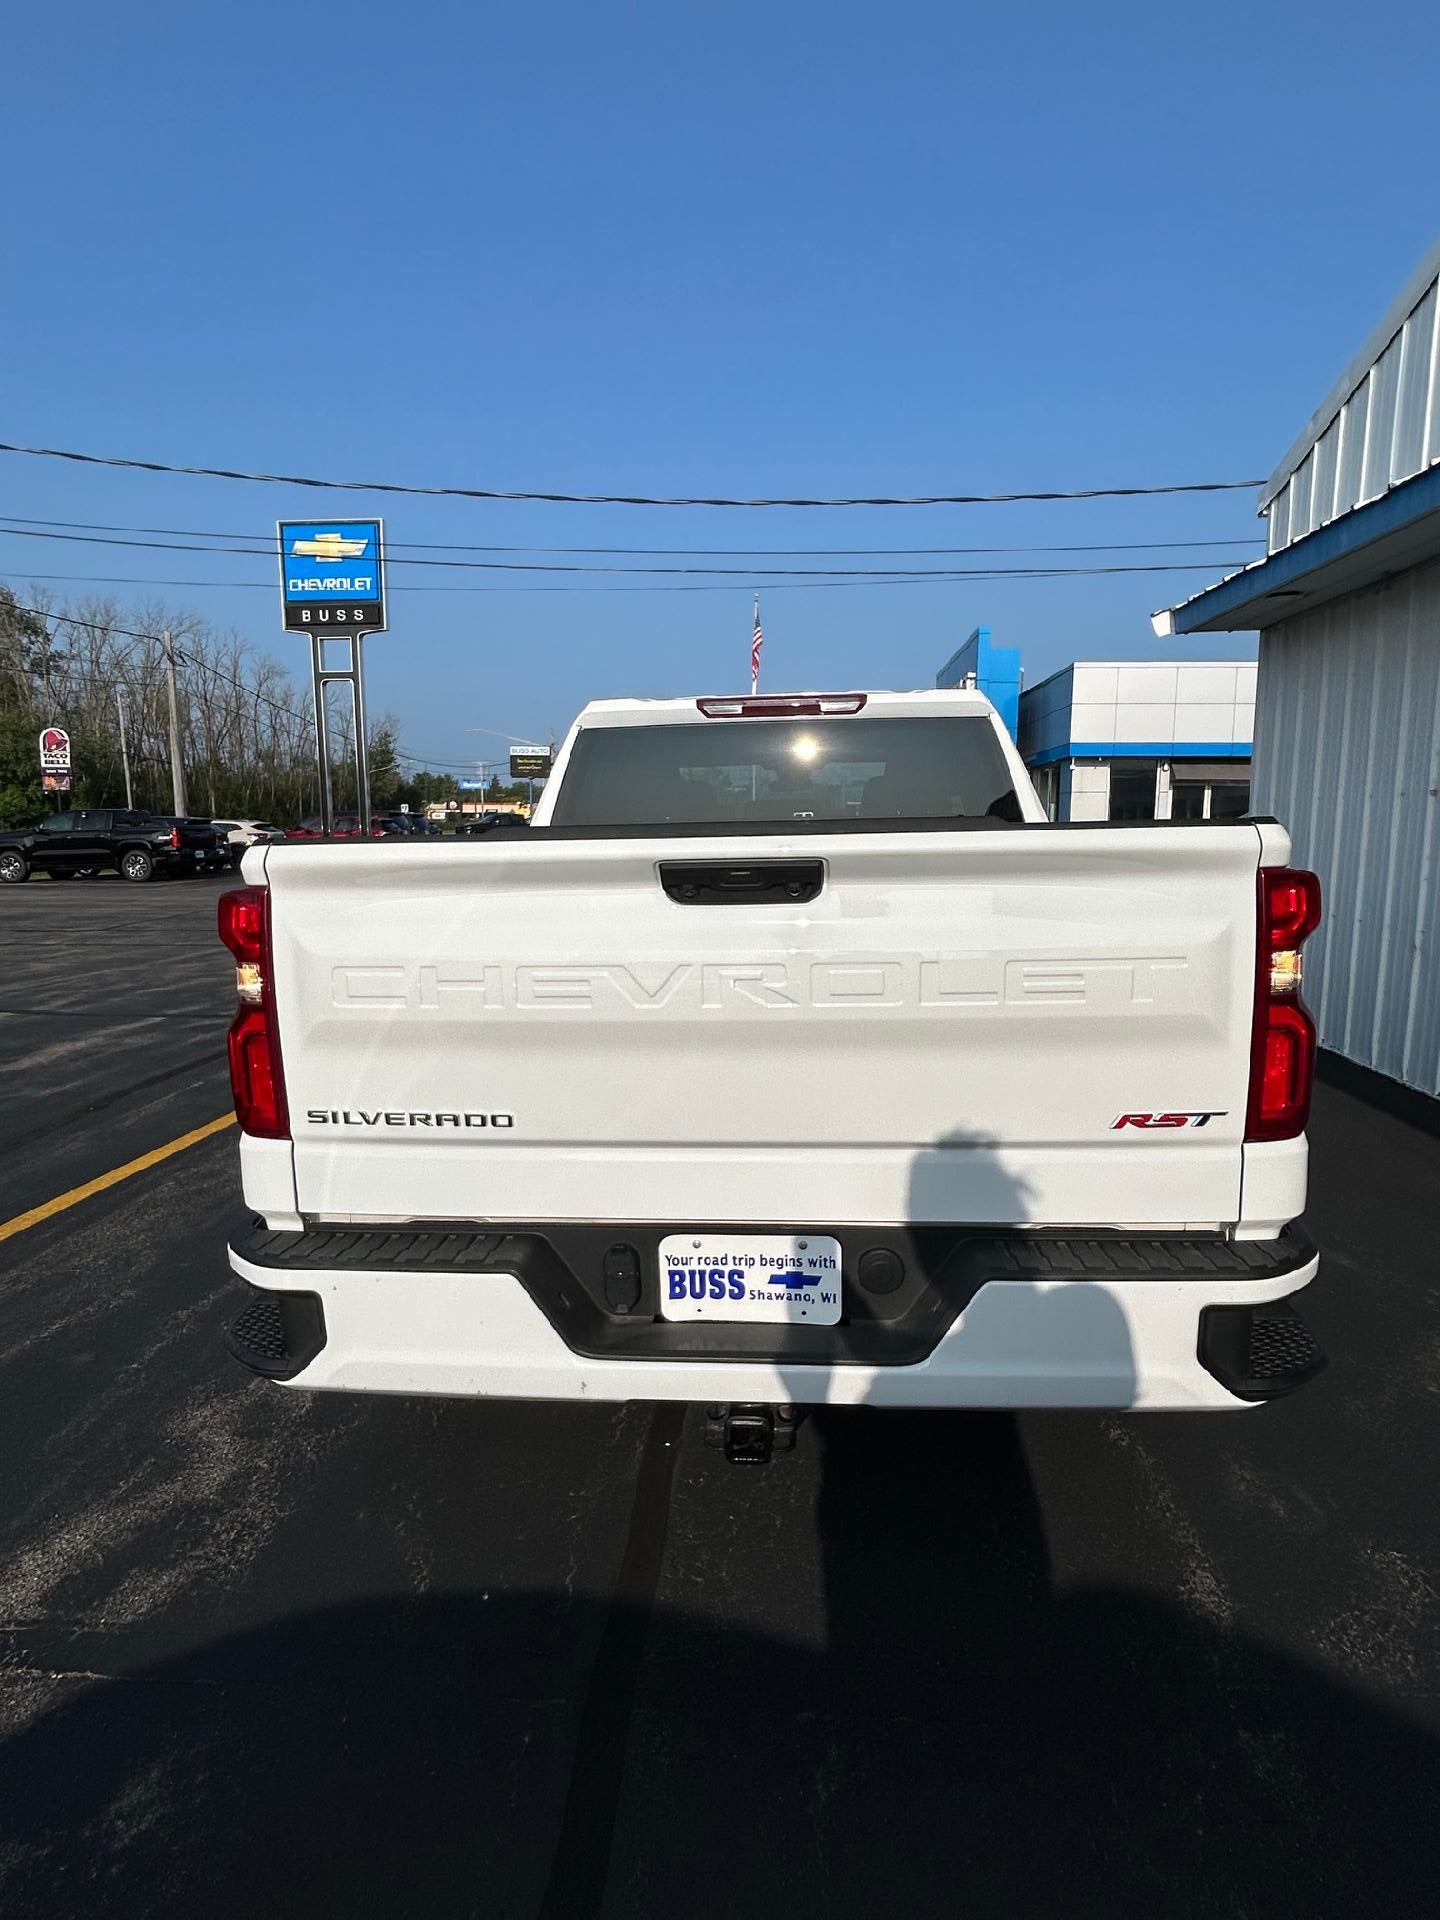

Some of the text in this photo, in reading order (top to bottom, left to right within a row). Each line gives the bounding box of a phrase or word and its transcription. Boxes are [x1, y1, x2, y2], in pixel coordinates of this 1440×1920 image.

[289, 577, 373, 591] CHEVROLET
[302, 609, 365, 622] BUSS
[331, 957, 1189, 1009] CHEVROLET
[307, 1109, 514, 1128] SILVERADO
[1109, 1110, 1229, 1129] RST
[665, 1254, 836, 1270] Your road trip begins with
[667, 1268, 746, 1301] BUSS
[749, 1290, 837, 1304] Shawano, WI
